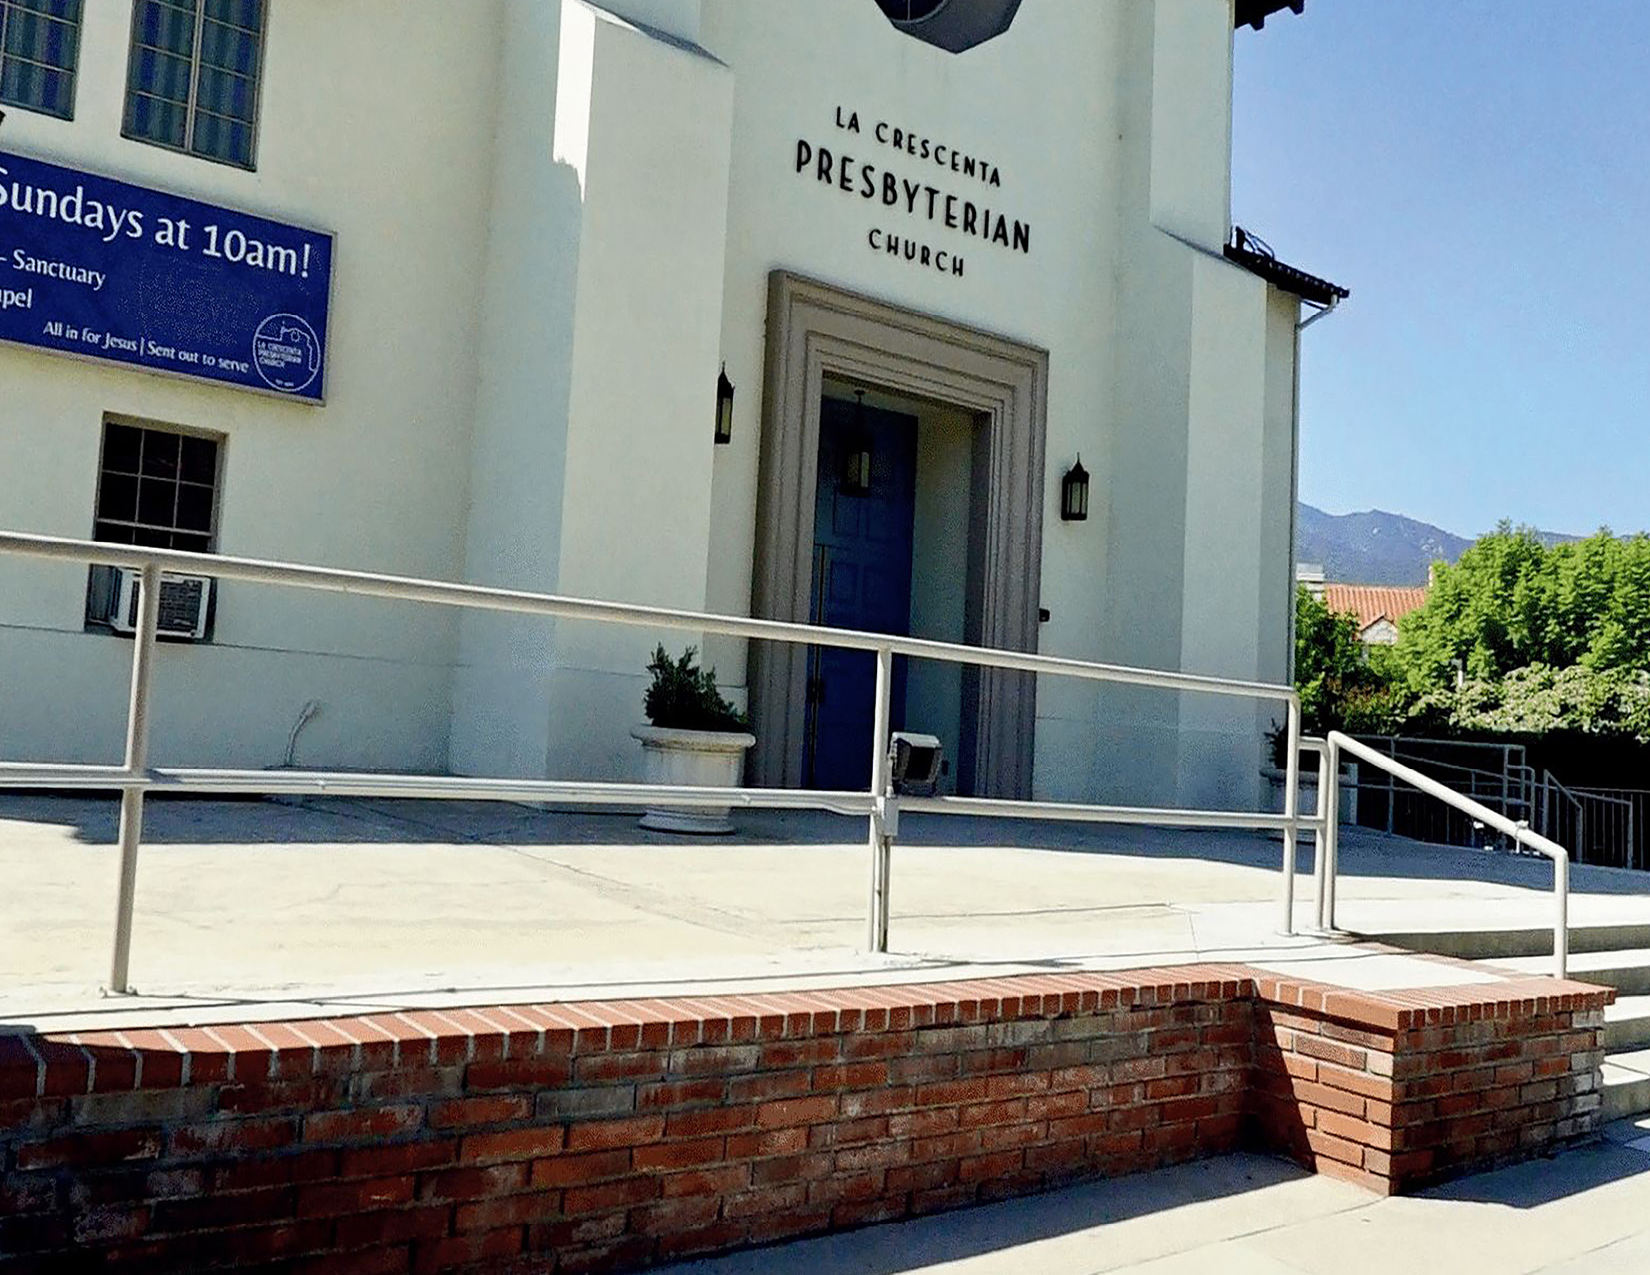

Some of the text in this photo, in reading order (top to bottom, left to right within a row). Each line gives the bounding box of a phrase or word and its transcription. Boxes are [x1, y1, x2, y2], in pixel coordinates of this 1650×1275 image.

[836, 105, 1001, 188] LA CRESCENTA
[796, 139, 1030, 254] PRESBYTERIAN
[12, 248, 106, 291] Sanctuary
[154, 217, 191, 250] at
[202, 224, 311, 278] 10am!
[868, 228, 964, 277] CHURCH
[43, 321, 63, 336] All
[65, 325, 78, 340] in
[82, 328, 101, 344] for
[102, 333, 137, 351] Jesus
[147, 341, 175, 359] Sent
[178, 347, 199, 364] out
[202, 353, 216, 366] to
[217, 357, 250, 374] serve
